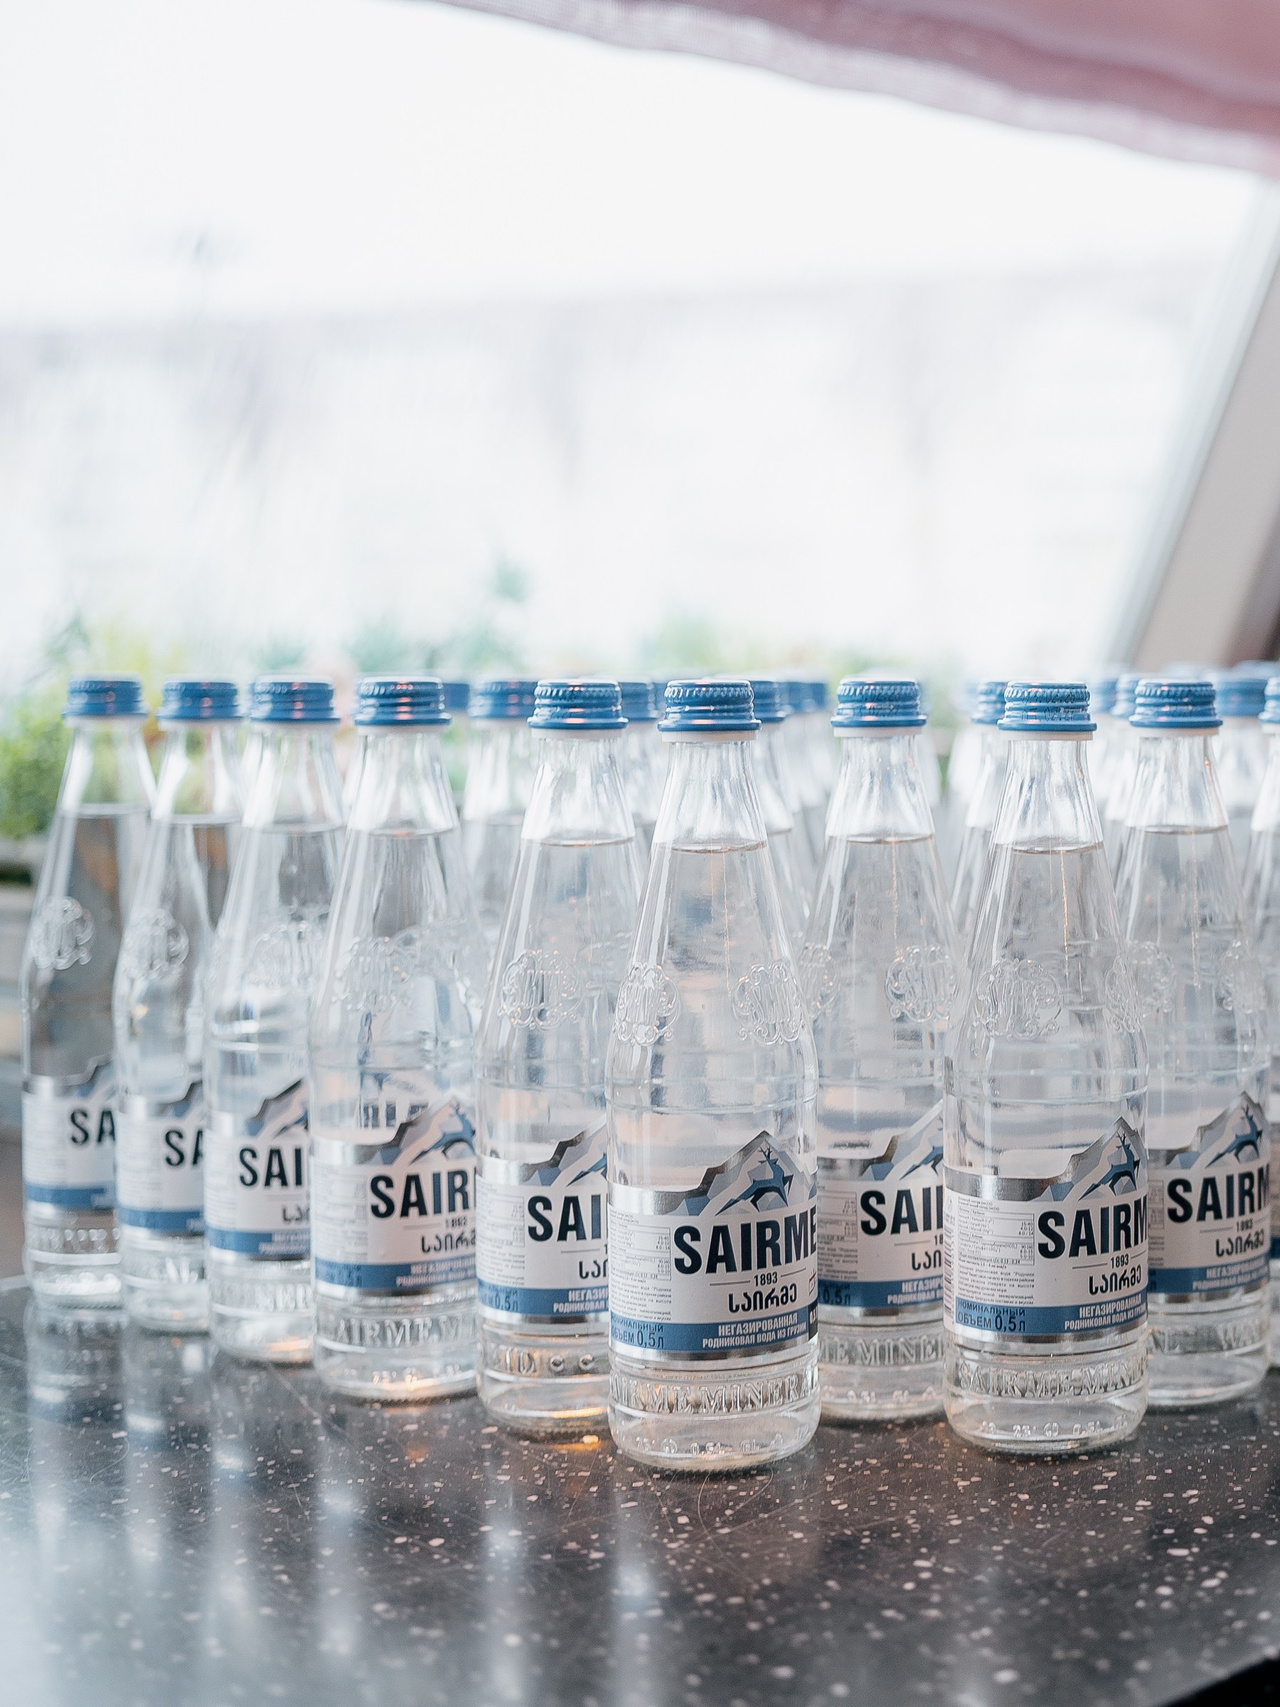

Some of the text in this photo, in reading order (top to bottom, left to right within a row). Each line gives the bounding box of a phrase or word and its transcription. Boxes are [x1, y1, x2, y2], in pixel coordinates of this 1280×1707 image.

[370, 1167, 476, 1219] SAIR
[528, 1194, 607, 1242] SAI
[674, 1205, 817, 1275] SAIRME
[1110, 1254, 1129, 1269] 1893
[753, 1271, 778, 1287] 1893
[718, 1312, 798, 1337] НЕГАЗИРОВАННАЯ
[958, 1311, 992, 1328] ОБЪЕМ
[702, 1335, 755, 1348] РОДНИКОВАЯ
[756, 1332, 776, 1344] ВОДА
[777, 1328, 786, 1340] ИЗ
